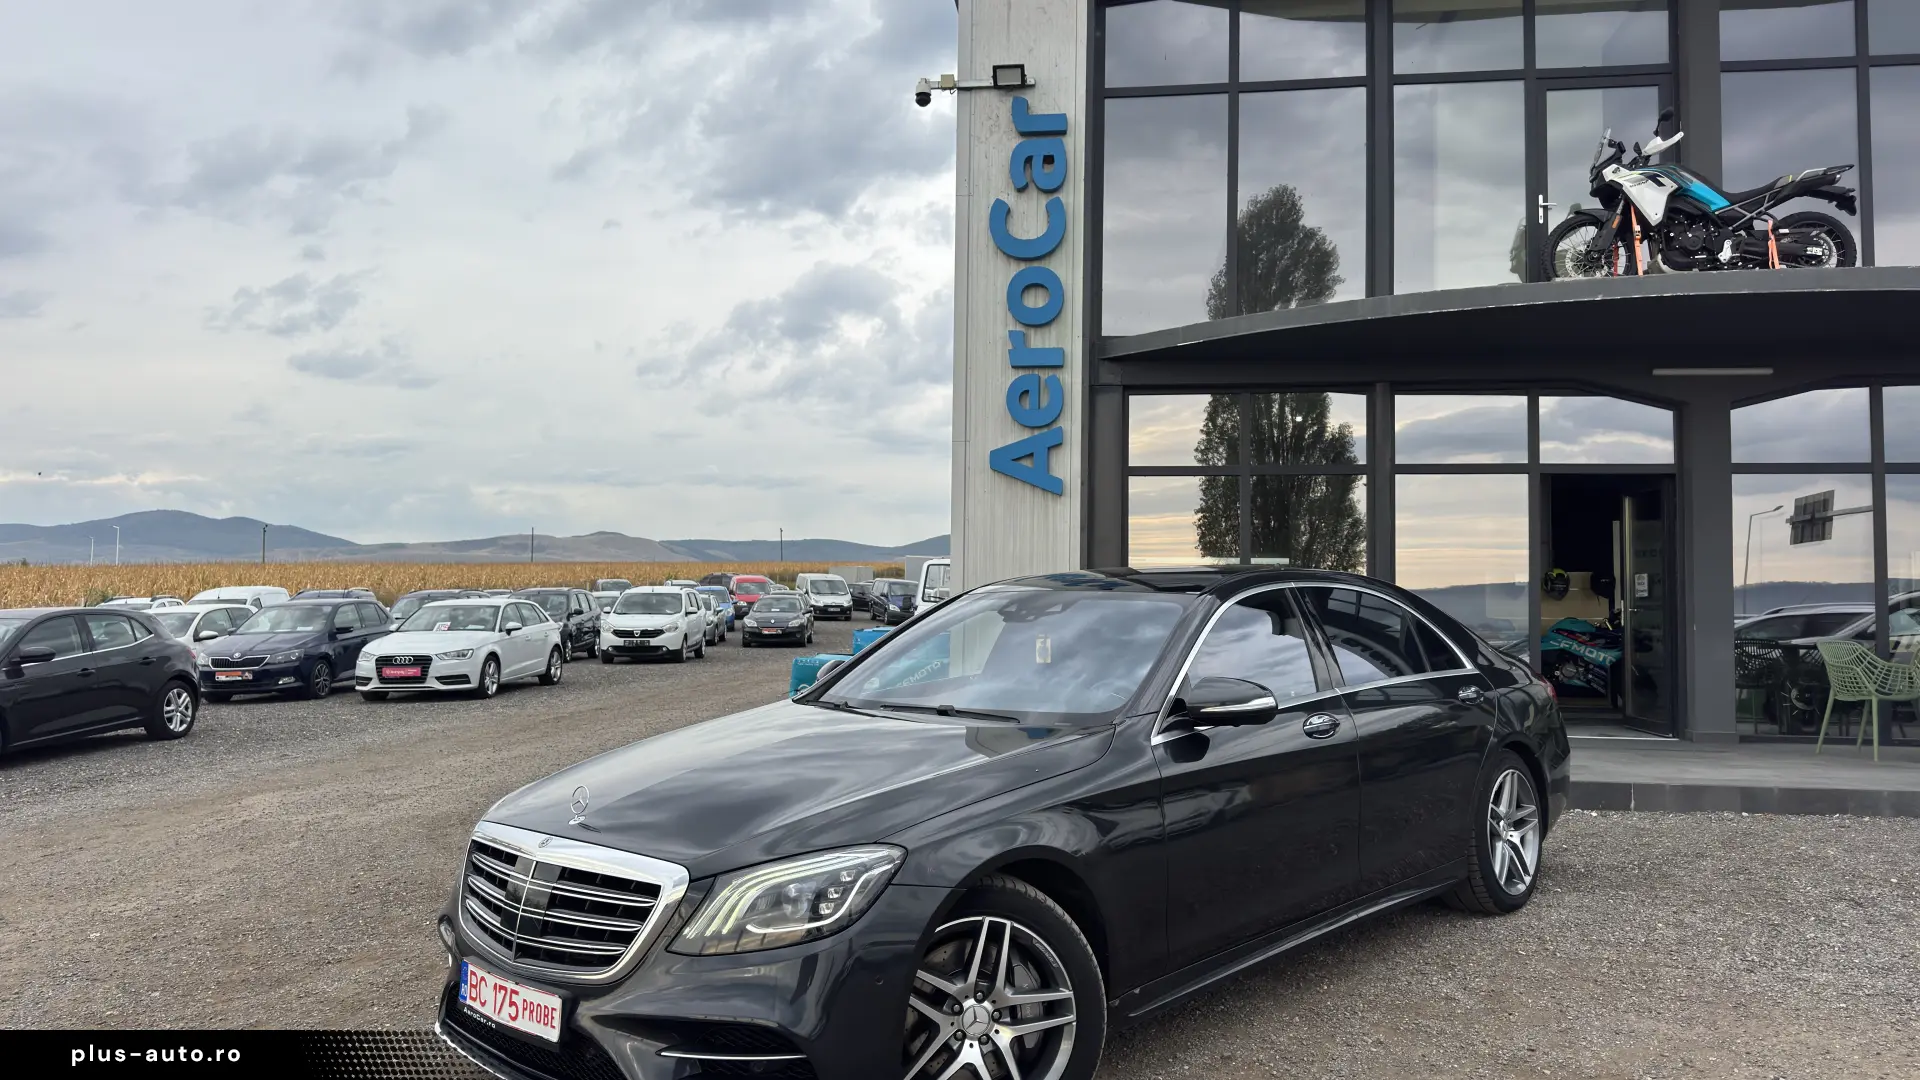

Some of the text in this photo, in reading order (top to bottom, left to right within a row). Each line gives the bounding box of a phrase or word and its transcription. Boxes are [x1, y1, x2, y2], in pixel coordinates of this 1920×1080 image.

[989, 96, 1068, 496] AeroCar
[896, 659, 941, 687] FMOTO
[463, 1007, 496, 1029] AeroCar.ro
[469, 969, 557, 1029] BC 175 PROBE
